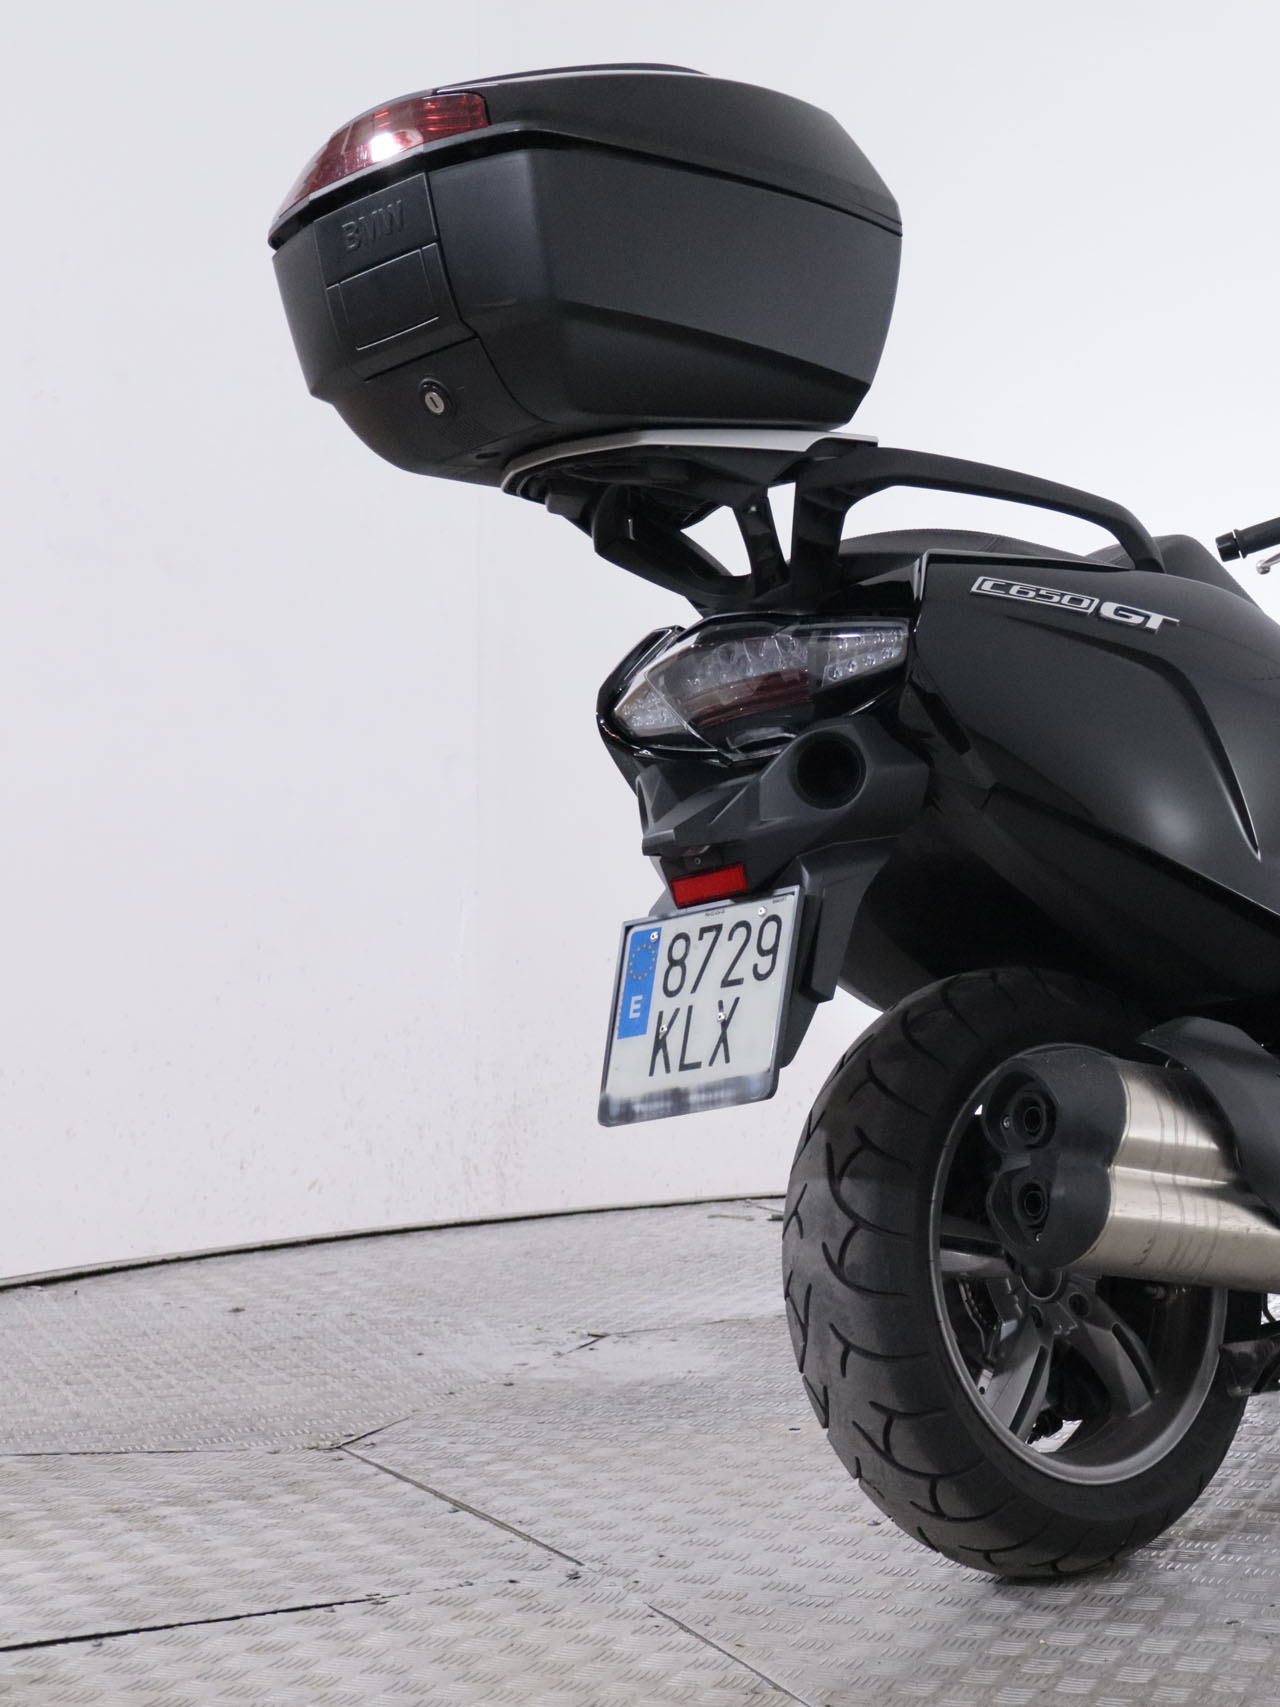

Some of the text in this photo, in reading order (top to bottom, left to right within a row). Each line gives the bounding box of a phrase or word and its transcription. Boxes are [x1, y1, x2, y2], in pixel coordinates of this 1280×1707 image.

[342, 200, 405, 250] BMW
[1099, 601, 1180, 634] GT
[662, 913, 783, 998] 8729
[628, 994, 644, 1020] E
[648, 996, 741, 1077] KLX
